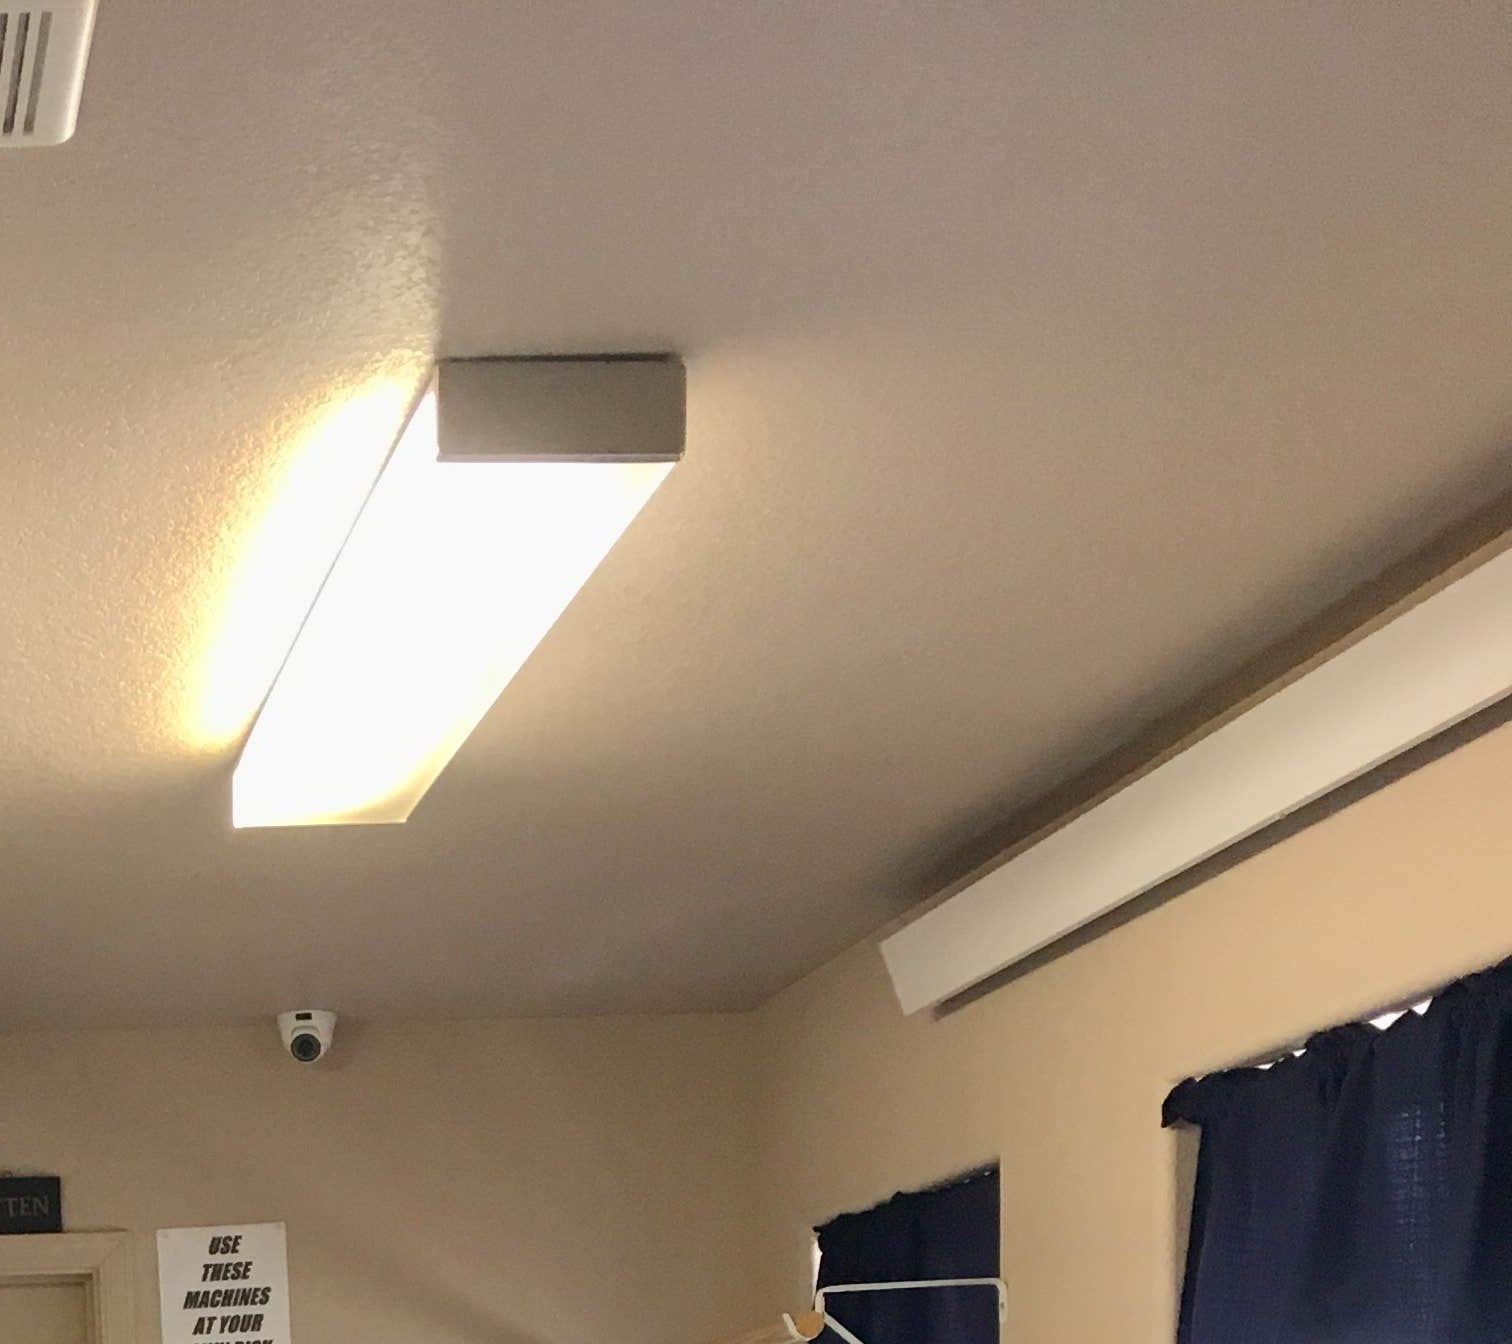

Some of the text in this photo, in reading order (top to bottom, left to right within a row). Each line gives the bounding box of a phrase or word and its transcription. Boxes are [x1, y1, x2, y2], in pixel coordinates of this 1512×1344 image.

[208, 1235, 242, 1255] USE
[201, 1261, 253, 1282] THESE
[183, 1286, 271, 1310] MACHINES
[192, 1314, 264, 1335] AT YOUR
